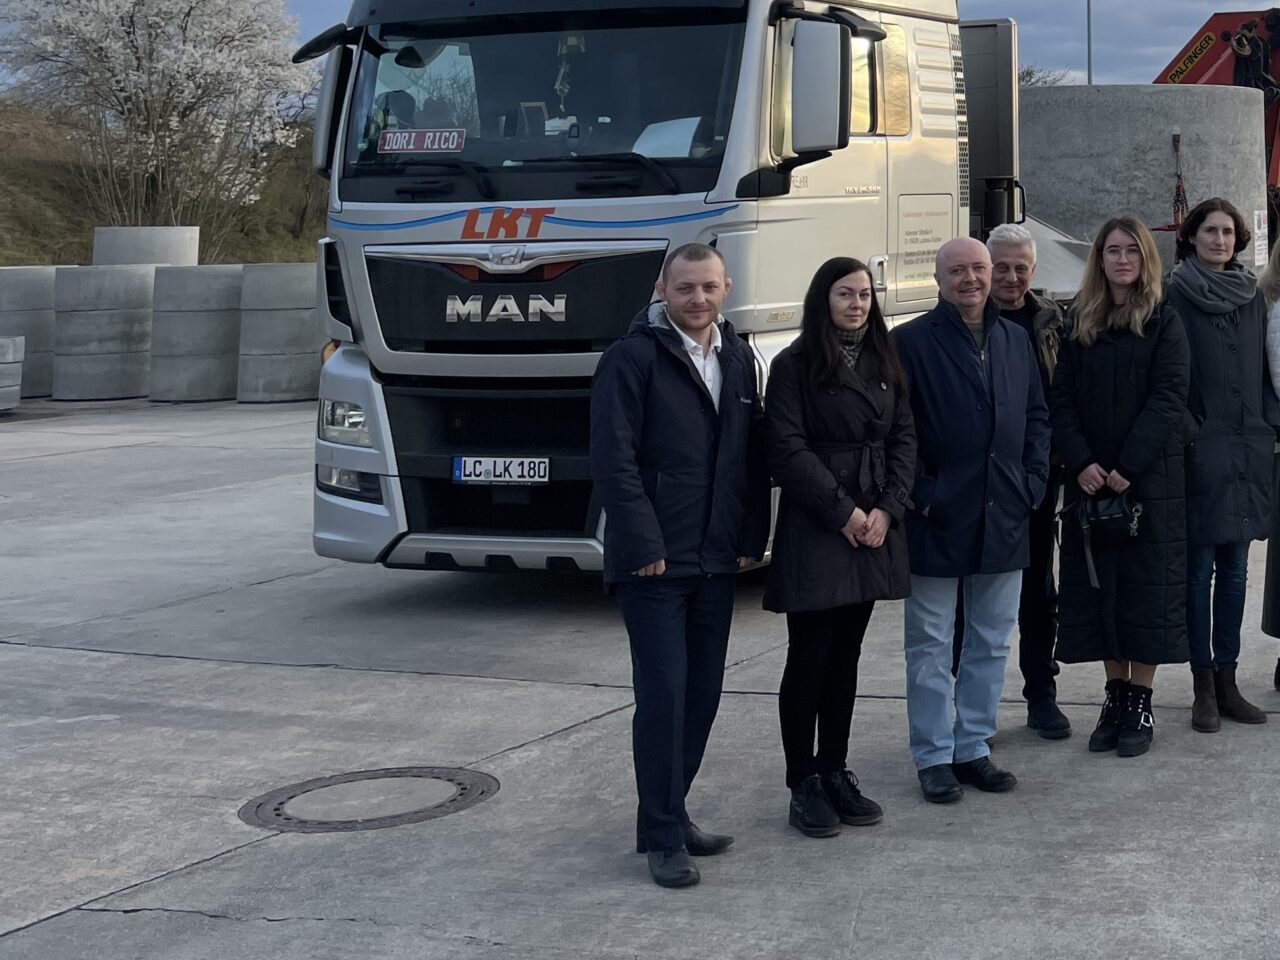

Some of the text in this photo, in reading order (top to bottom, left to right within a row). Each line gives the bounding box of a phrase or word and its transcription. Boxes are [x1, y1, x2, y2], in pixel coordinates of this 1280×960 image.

[1168, 34, 1214, 83] PALFINGER
[384, 131, 458, 150] DORI RICO
[460, 208, 556, 239] LKT
[446, 293, 568, 323] MAN
[463, 460, 482, 478] LC
[493, 460, 513, 479] LK
[517, 461, 548, 479] 180
